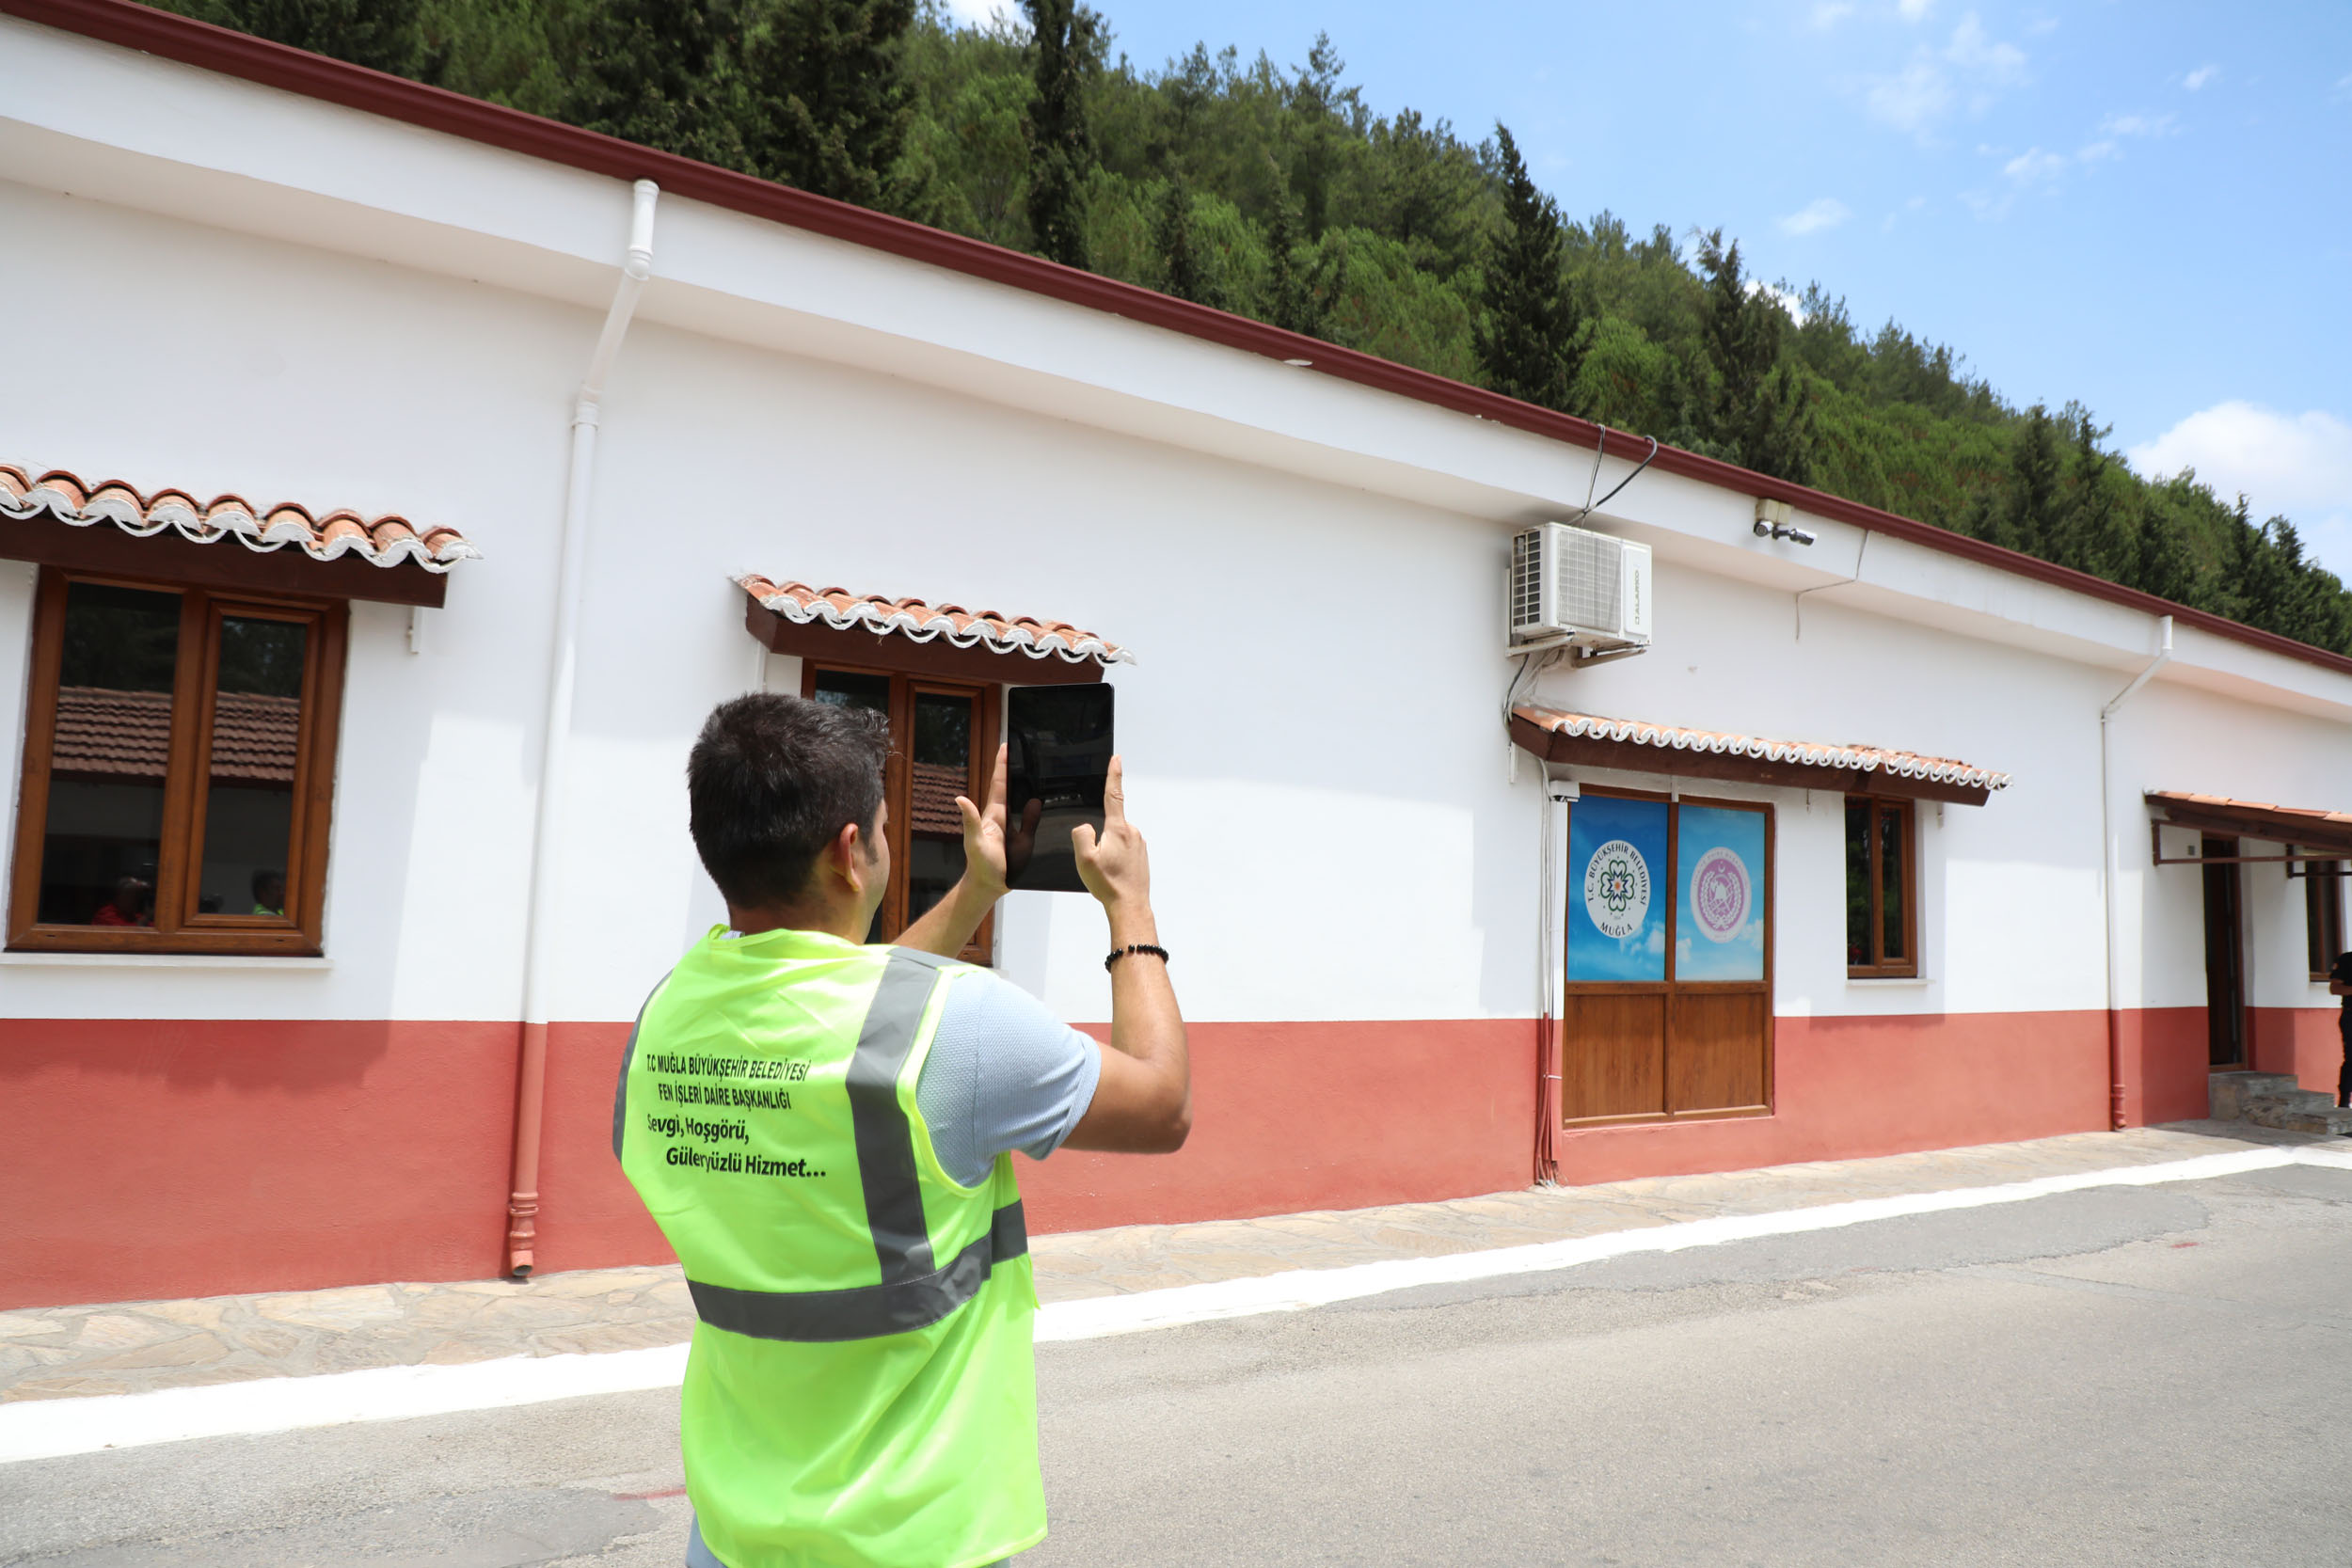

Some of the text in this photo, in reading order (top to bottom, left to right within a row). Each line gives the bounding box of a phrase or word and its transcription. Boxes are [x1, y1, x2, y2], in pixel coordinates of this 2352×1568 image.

[1589, 843, 1629, 879] BÜYÜKŞEHİR
[1629, 850, 1648, 905] BELEDİYESİ
[1600, 922, 1633, 936] MUĞLA
[646, 1052, 812, 1082] T.C MUĞLA BÜYÜKŞEHİR BELEDİYESİ
[659, 1081, 791, 1112] FEN İŞLERİ DAİRE BAŞKANLIĞI
[647, 1114, 750, 1145] Sevgi, Hoşgörü,
[666, 1146, 826, 1178] Güleryüzlü Hizmet...
